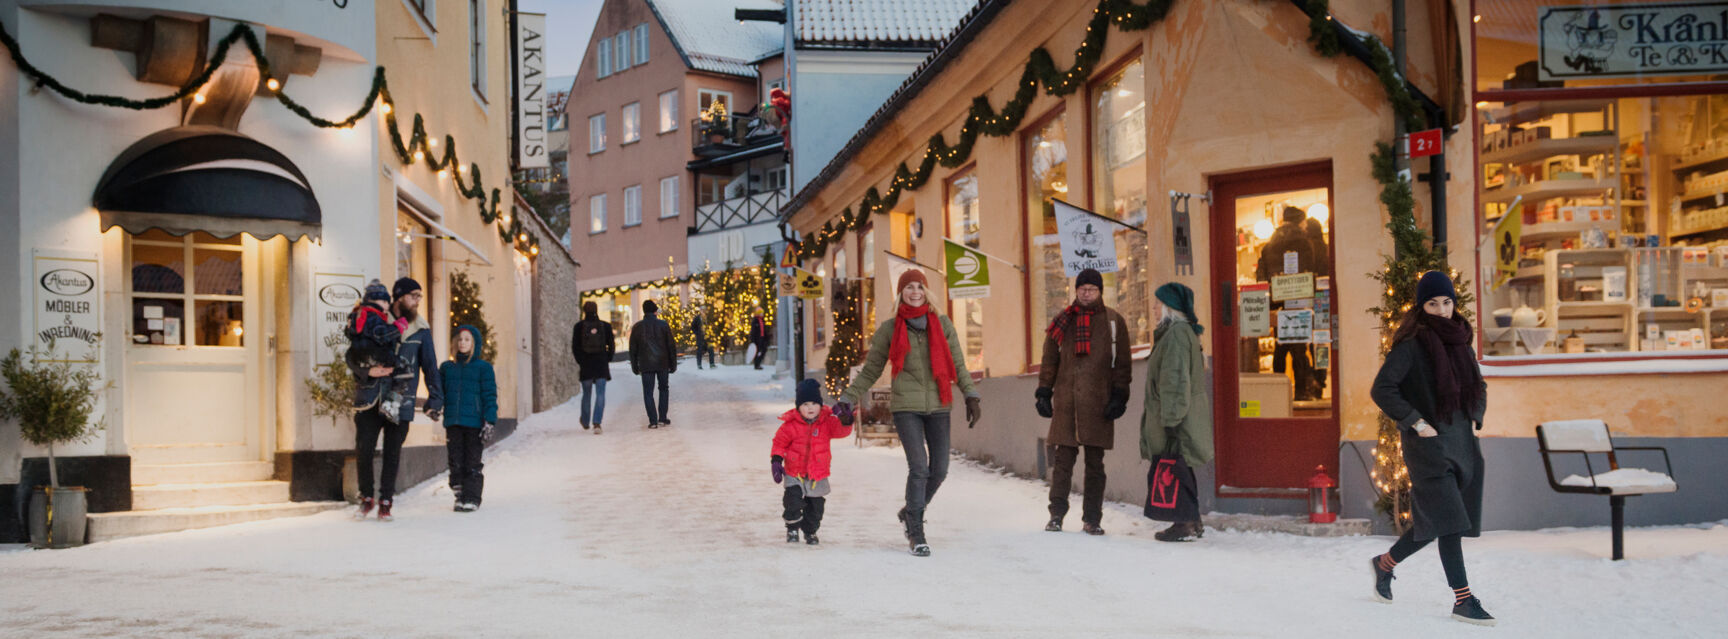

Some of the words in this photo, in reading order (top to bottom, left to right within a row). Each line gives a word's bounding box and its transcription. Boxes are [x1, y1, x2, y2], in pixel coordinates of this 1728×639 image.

[1629, 45, 1662, 67] Te
[1666, 44, 1698, 65] &
[523, 26, 544, 158] AKANTUS
[47, 273, 88, 290] Akantus
[46, 299, 90, 313] MÖBLER
[64, 314, 73, 325] &
[38, 325, 97, 344] INREDNING
